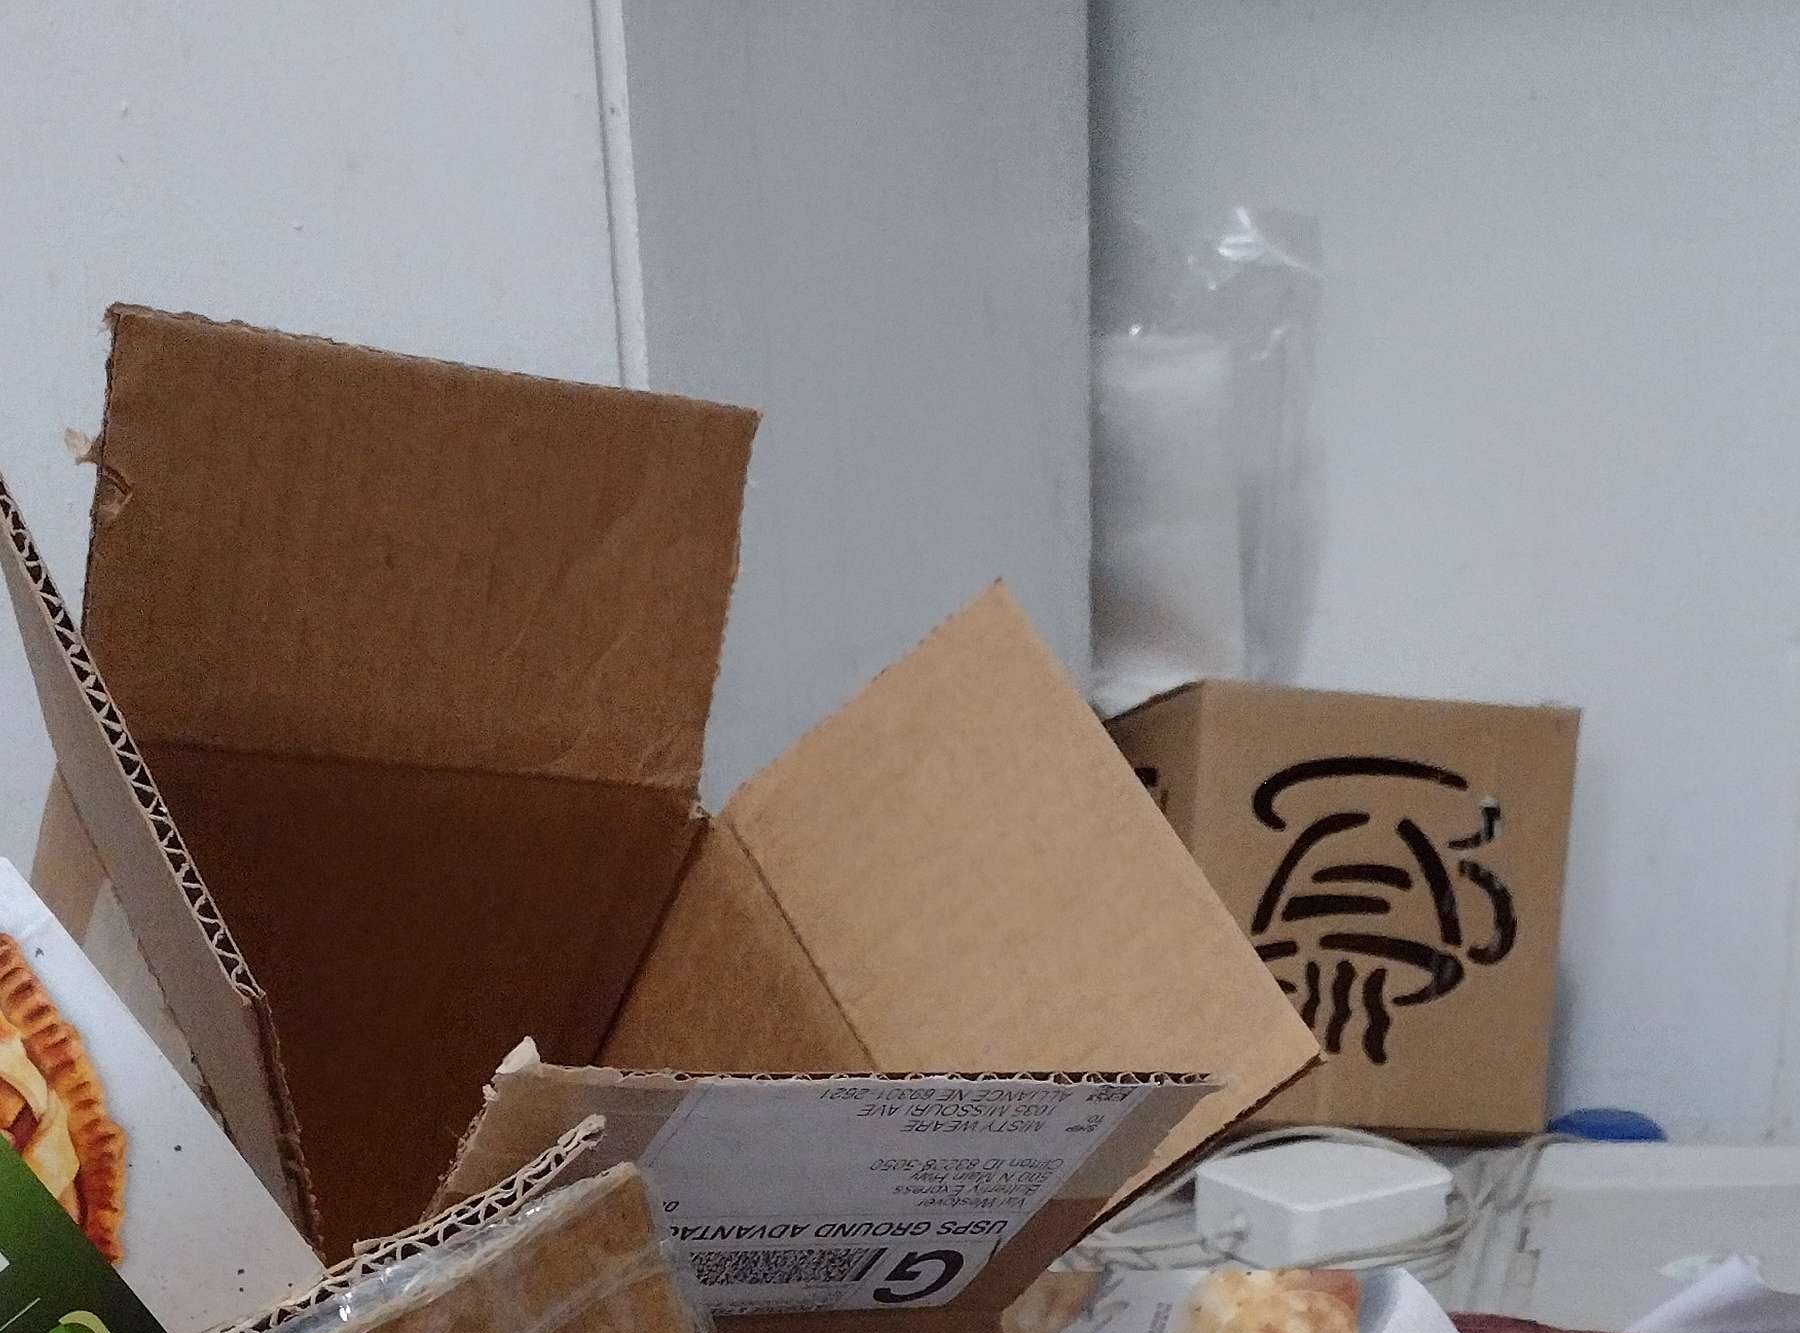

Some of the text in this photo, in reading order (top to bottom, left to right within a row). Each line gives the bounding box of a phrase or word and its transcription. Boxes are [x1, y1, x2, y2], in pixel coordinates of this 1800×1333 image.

[934, 1088, 969, 1100] NE
[968, 1088, 1074, 1101] ALLIANCE
[854, 1103, 900, 1117] AVE
[903, 1103, 1011, 1116] MISSOURI
[899, 1120, 980, 1132] WEARE
[981, 1158, 1006, 1169] ID
[949, 1171, 996, 1183] Main
[996, 1172, 1015, 1182] N
[813, 1221, 933, 1237] GROUND
[934, 1219, 1010, 1235] USPS
